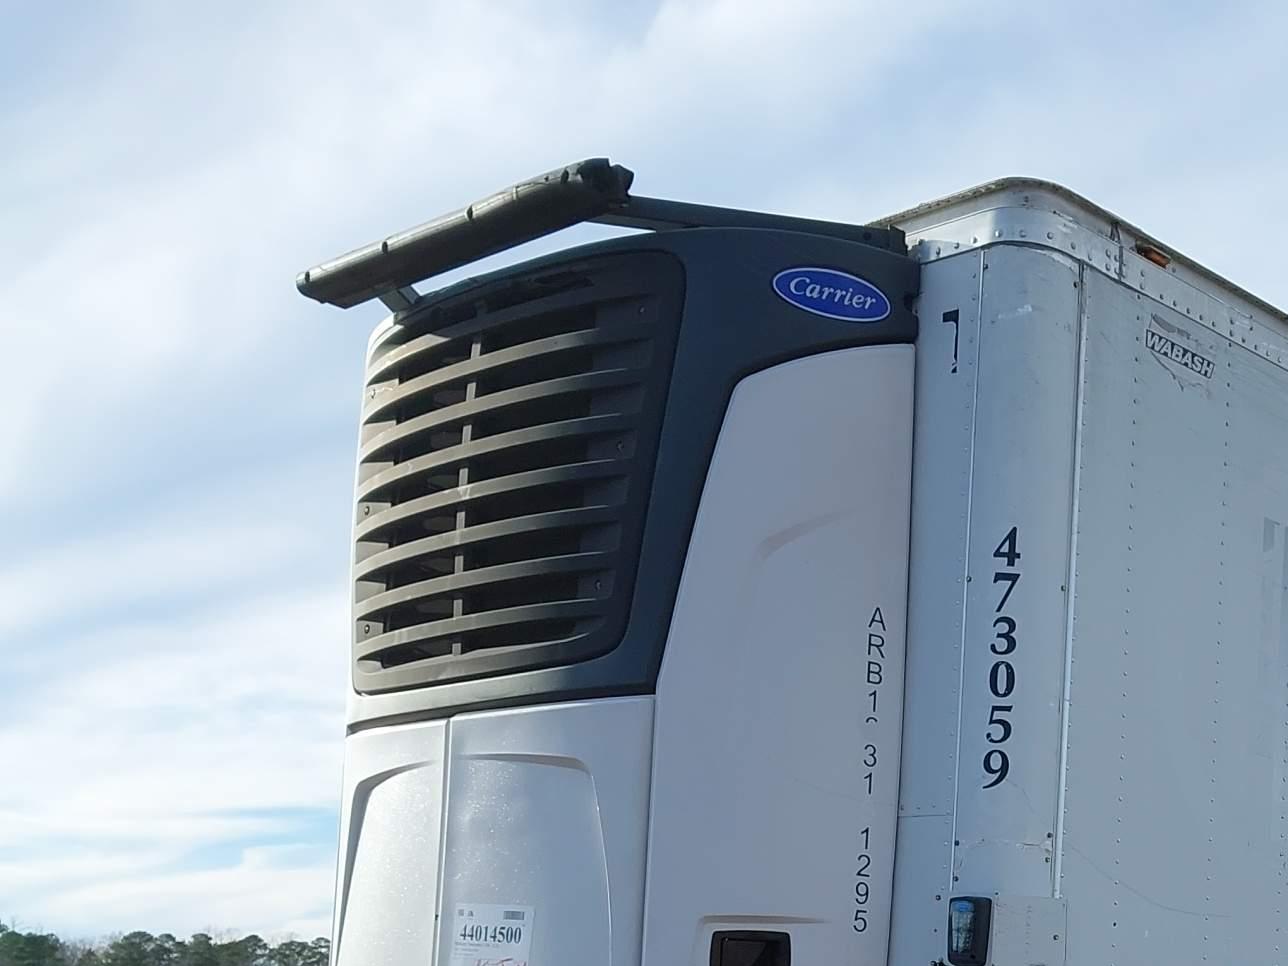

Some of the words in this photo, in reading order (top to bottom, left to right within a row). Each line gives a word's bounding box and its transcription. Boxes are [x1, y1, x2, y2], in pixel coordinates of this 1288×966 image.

[789, 277, 876, 310] Carrier
[1147, 331, 1214, 379] WABASH
[982, 526, 1021, 789] 473059
[863, 606, 887, 795] ARB131
[459, 924, 522, 944] 44014500
